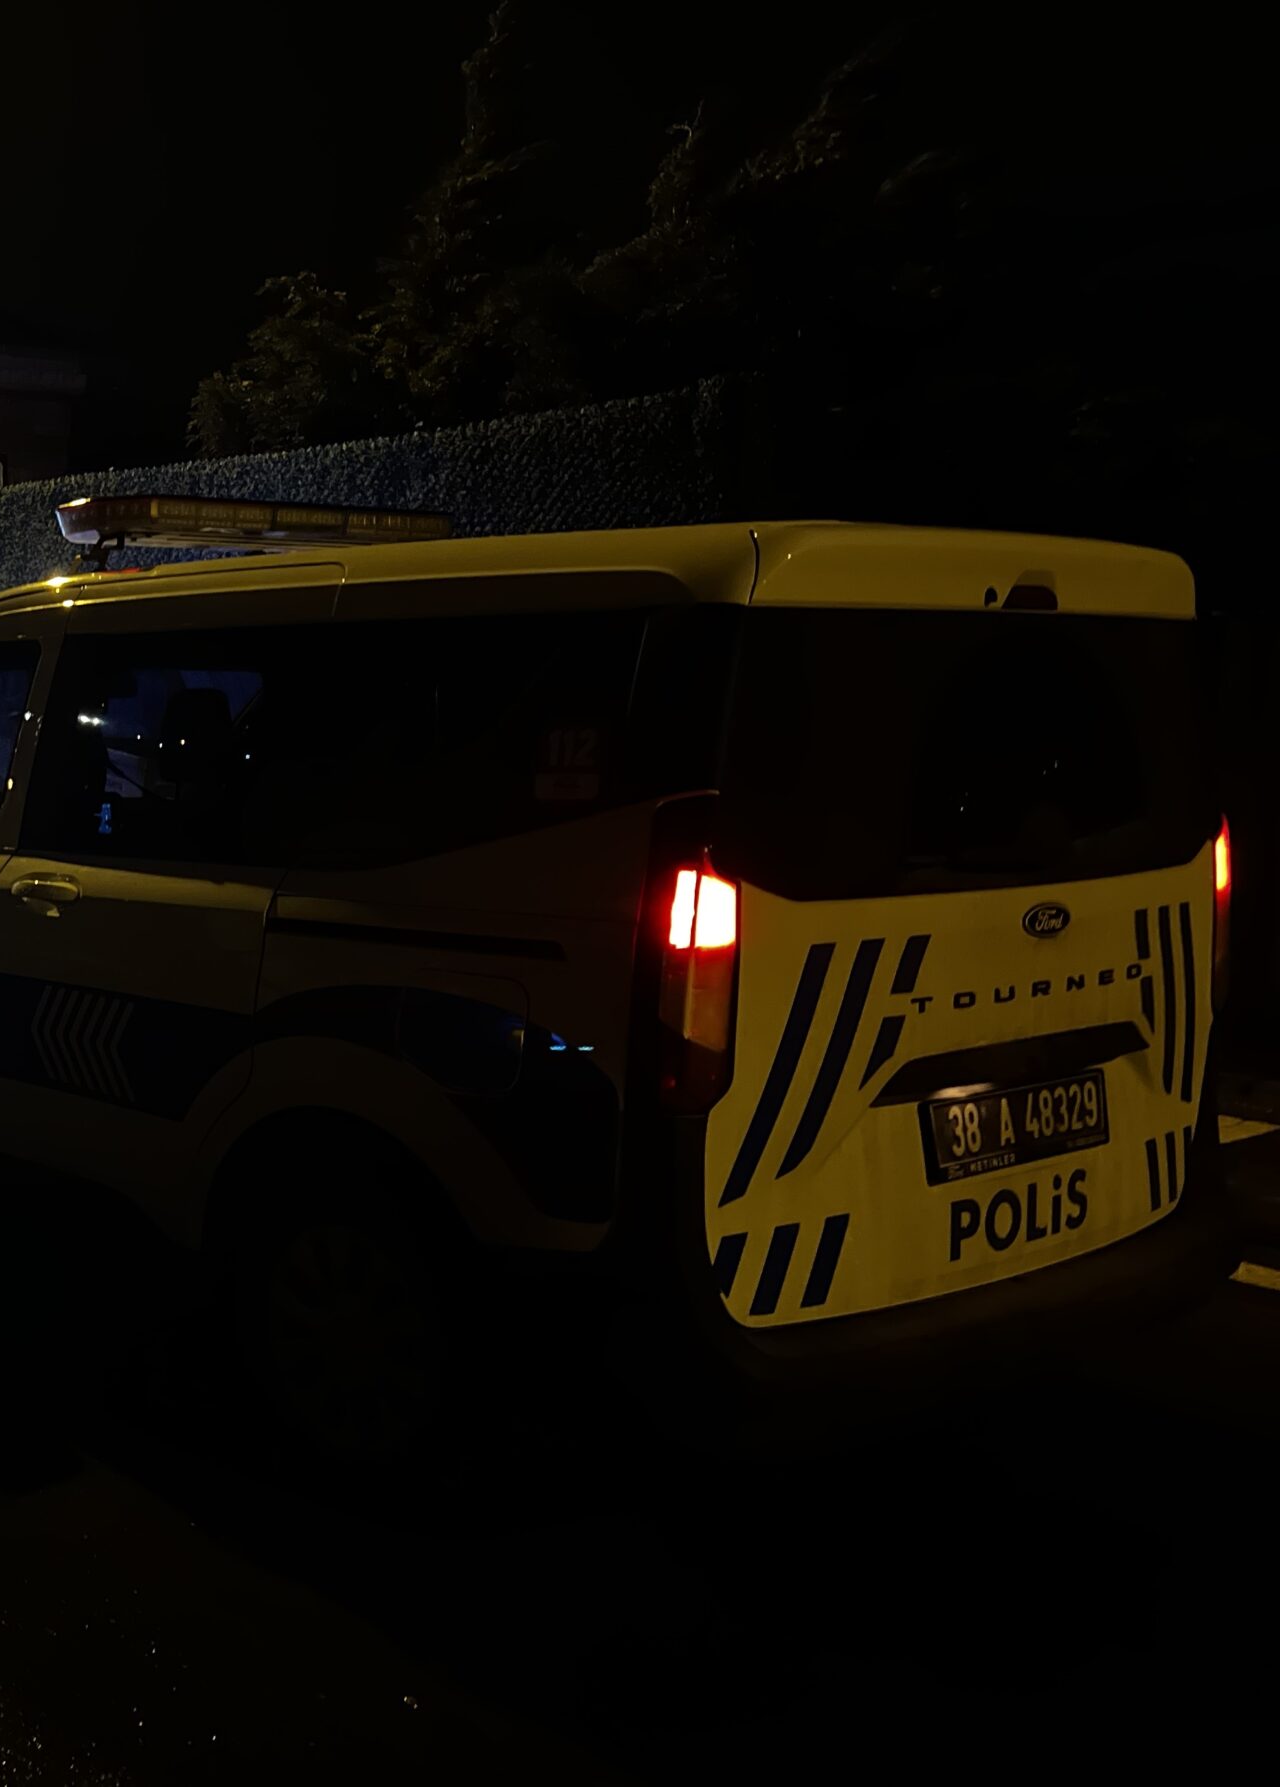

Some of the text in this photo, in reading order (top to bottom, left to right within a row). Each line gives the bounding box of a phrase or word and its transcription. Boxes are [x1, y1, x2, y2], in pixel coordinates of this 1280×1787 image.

[548, 728, 599, 768] 112
[1035, 909, 1064, 932] Ford
[910, 963, 1142, 1014] TOURNEO
[948, 1081, 1098, 1157] 38 A 48329
